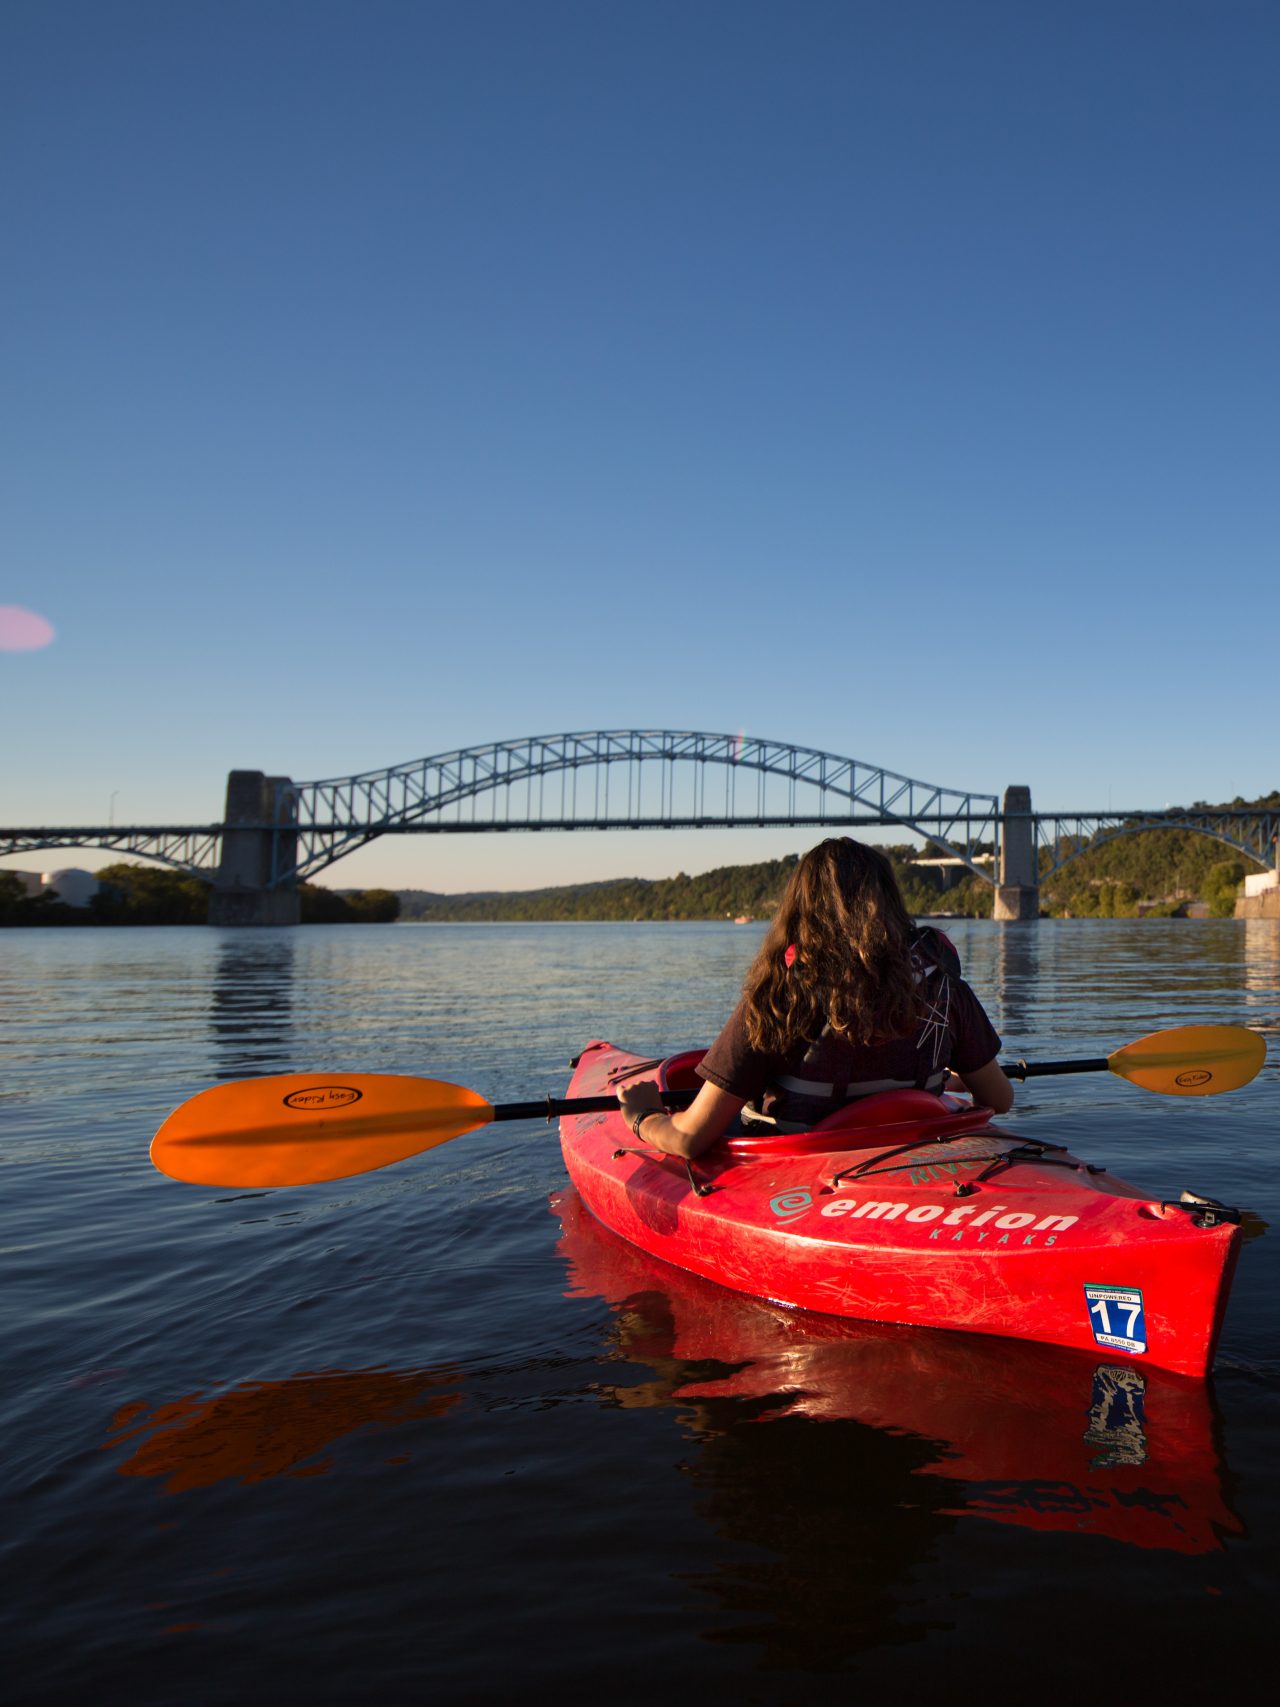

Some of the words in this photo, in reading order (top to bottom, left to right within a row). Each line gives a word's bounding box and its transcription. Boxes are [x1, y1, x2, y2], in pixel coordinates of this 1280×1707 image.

[820, 1199, 1080, 1231] emotion
[929, 1229, 1058, 1246] KAYAKS
[1089, 1293, 1132, 1301] UNPOWERED
[1091, 1300, 1141, 1338] 17
